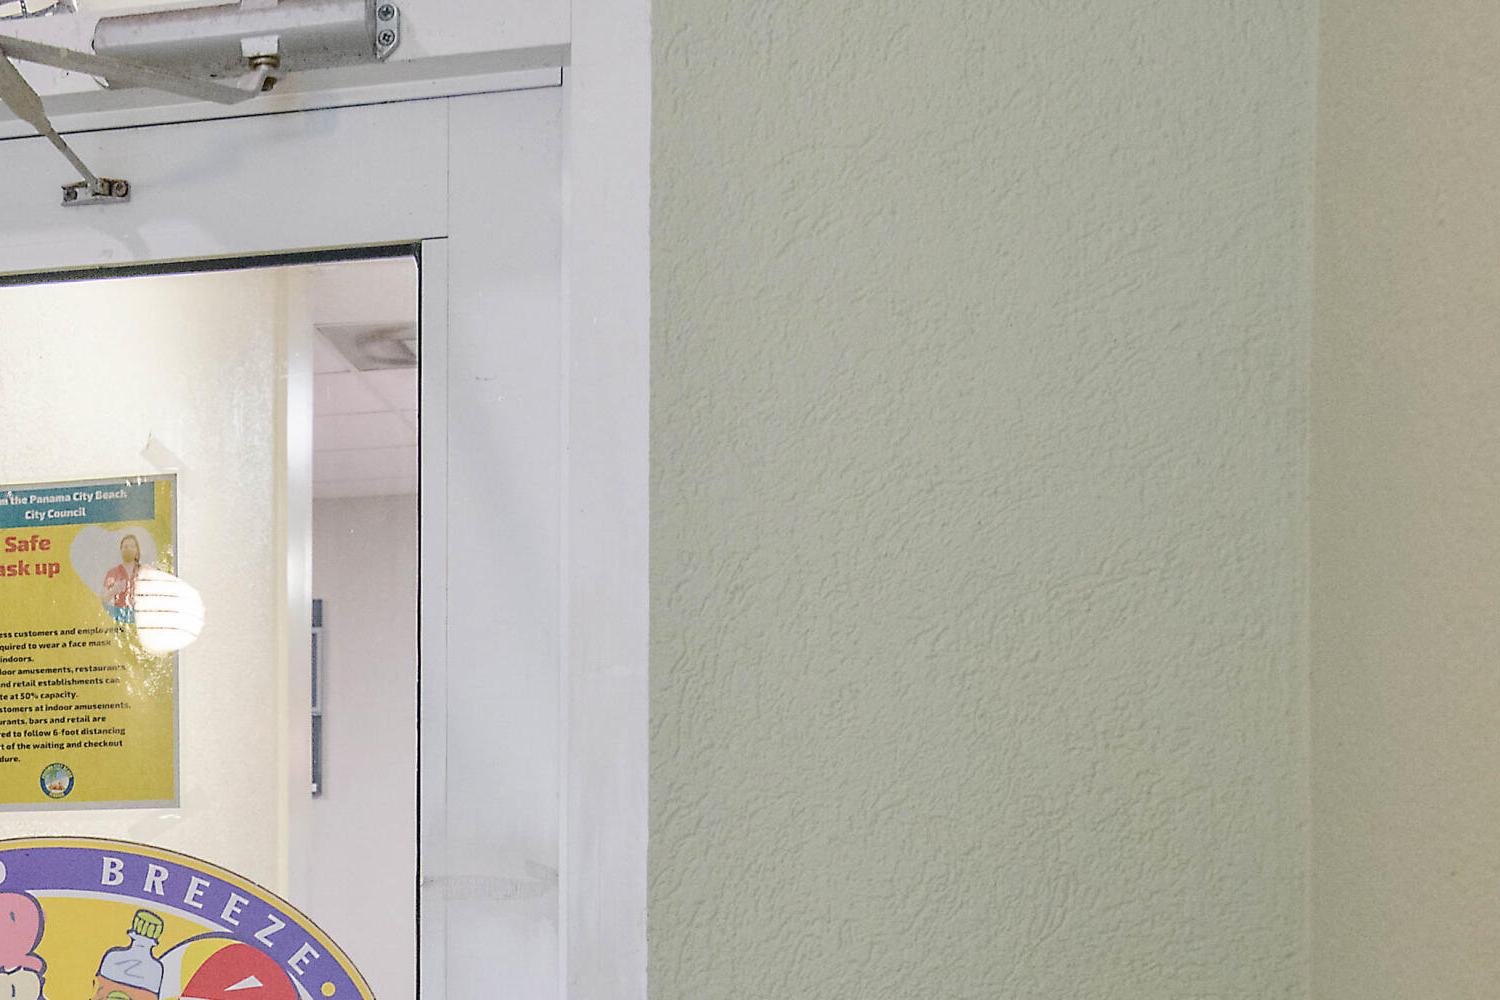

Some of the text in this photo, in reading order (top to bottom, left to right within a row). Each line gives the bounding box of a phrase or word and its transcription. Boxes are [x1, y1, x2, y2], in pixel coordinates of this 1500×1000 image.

[10, 496, 28, 505] the
[29, 494, 71, 504] Panama
[73, 492, 94, 502] City
[95, 489, 128, 500] Beach
[25, 507, 86, 521] City Council
[5, 535, 51, 553] Safe
[35, 562, 61, 578] up
[14, 630, 58, 638] customers
[0, 656, 34, 664] indoors.
[17, 667, 74, 675] amusements,
[13, 680, 36, 688] retail
[38, 678, 104, 687] establishments
[20, 692, 38, 700] 50%
[40, 691, 79, 700] capacity.
[74, 702, 131, 710] amusements,
[49, 716, 65, 724] and
[67, 715, 90, 723] retail
[81, 727, 126, 735] distancing
[6, 742, 15, 750] of
[32, 741, 64, 750] waiting
[66, 740, 82, 748] and
[101, 855, 322, 977] BREEZE
